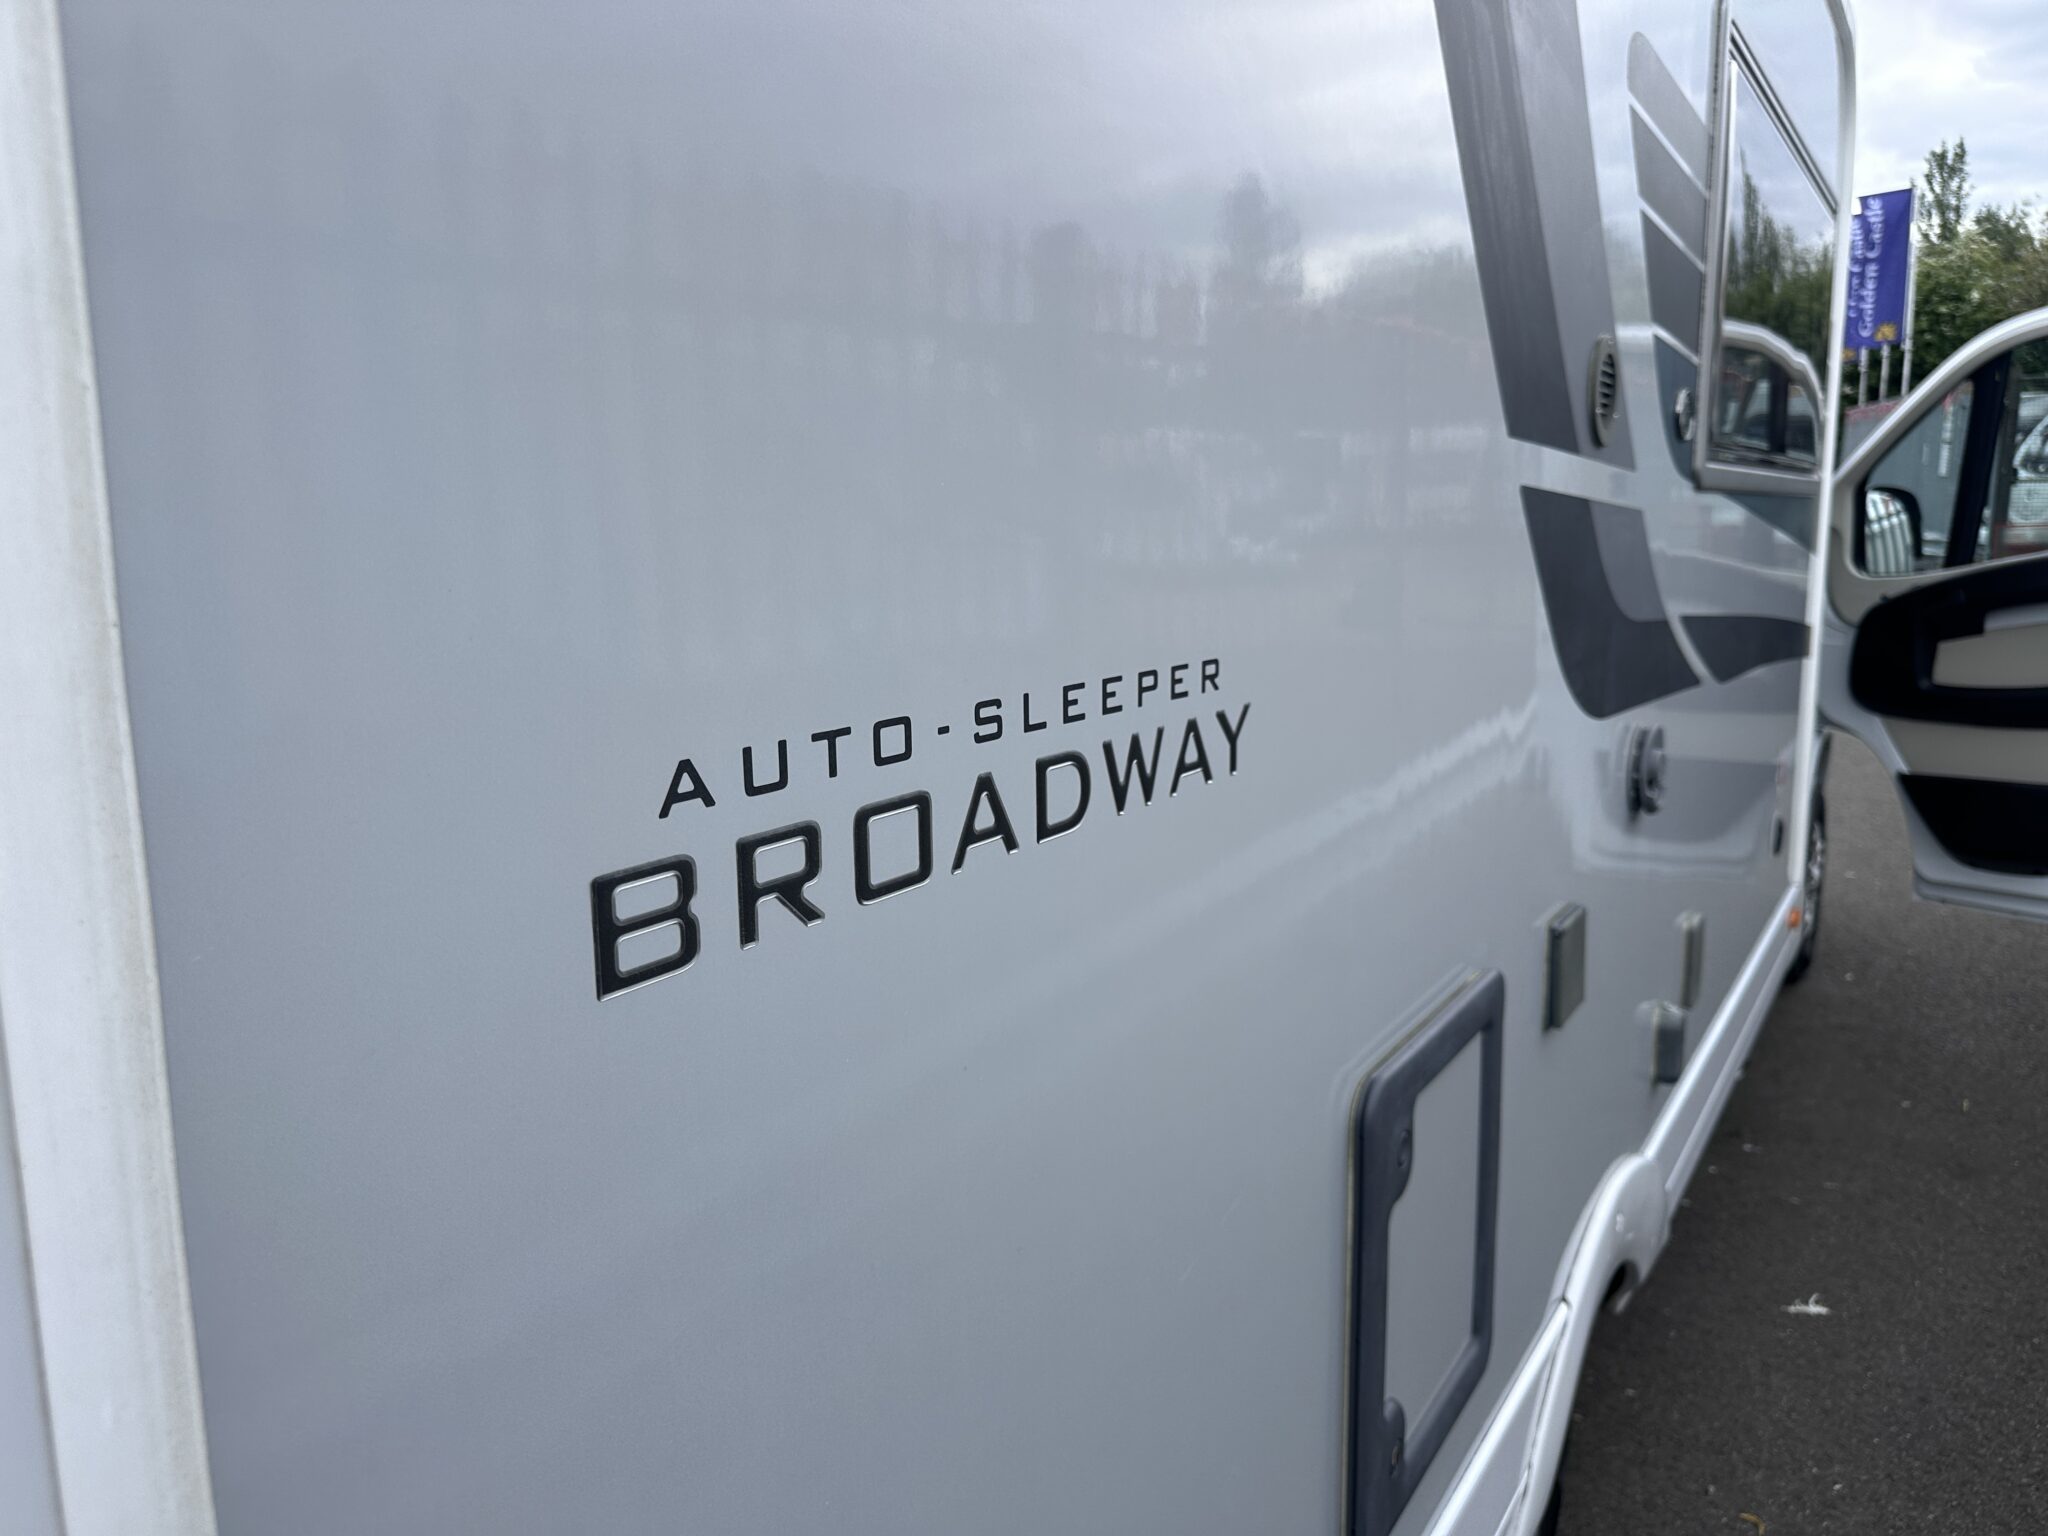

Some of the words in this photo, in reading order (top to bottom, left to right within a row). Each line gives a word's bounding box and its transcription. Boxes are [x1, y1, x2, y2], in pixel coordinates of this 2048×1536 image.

[1864, 196, 1885, 259] Castle
[1857, 262, 1880, 338] Golden
[658, 657, 1221, 820] AUTO-SLEEPER
[589, 702, 1252, 1003] BROADWAY
